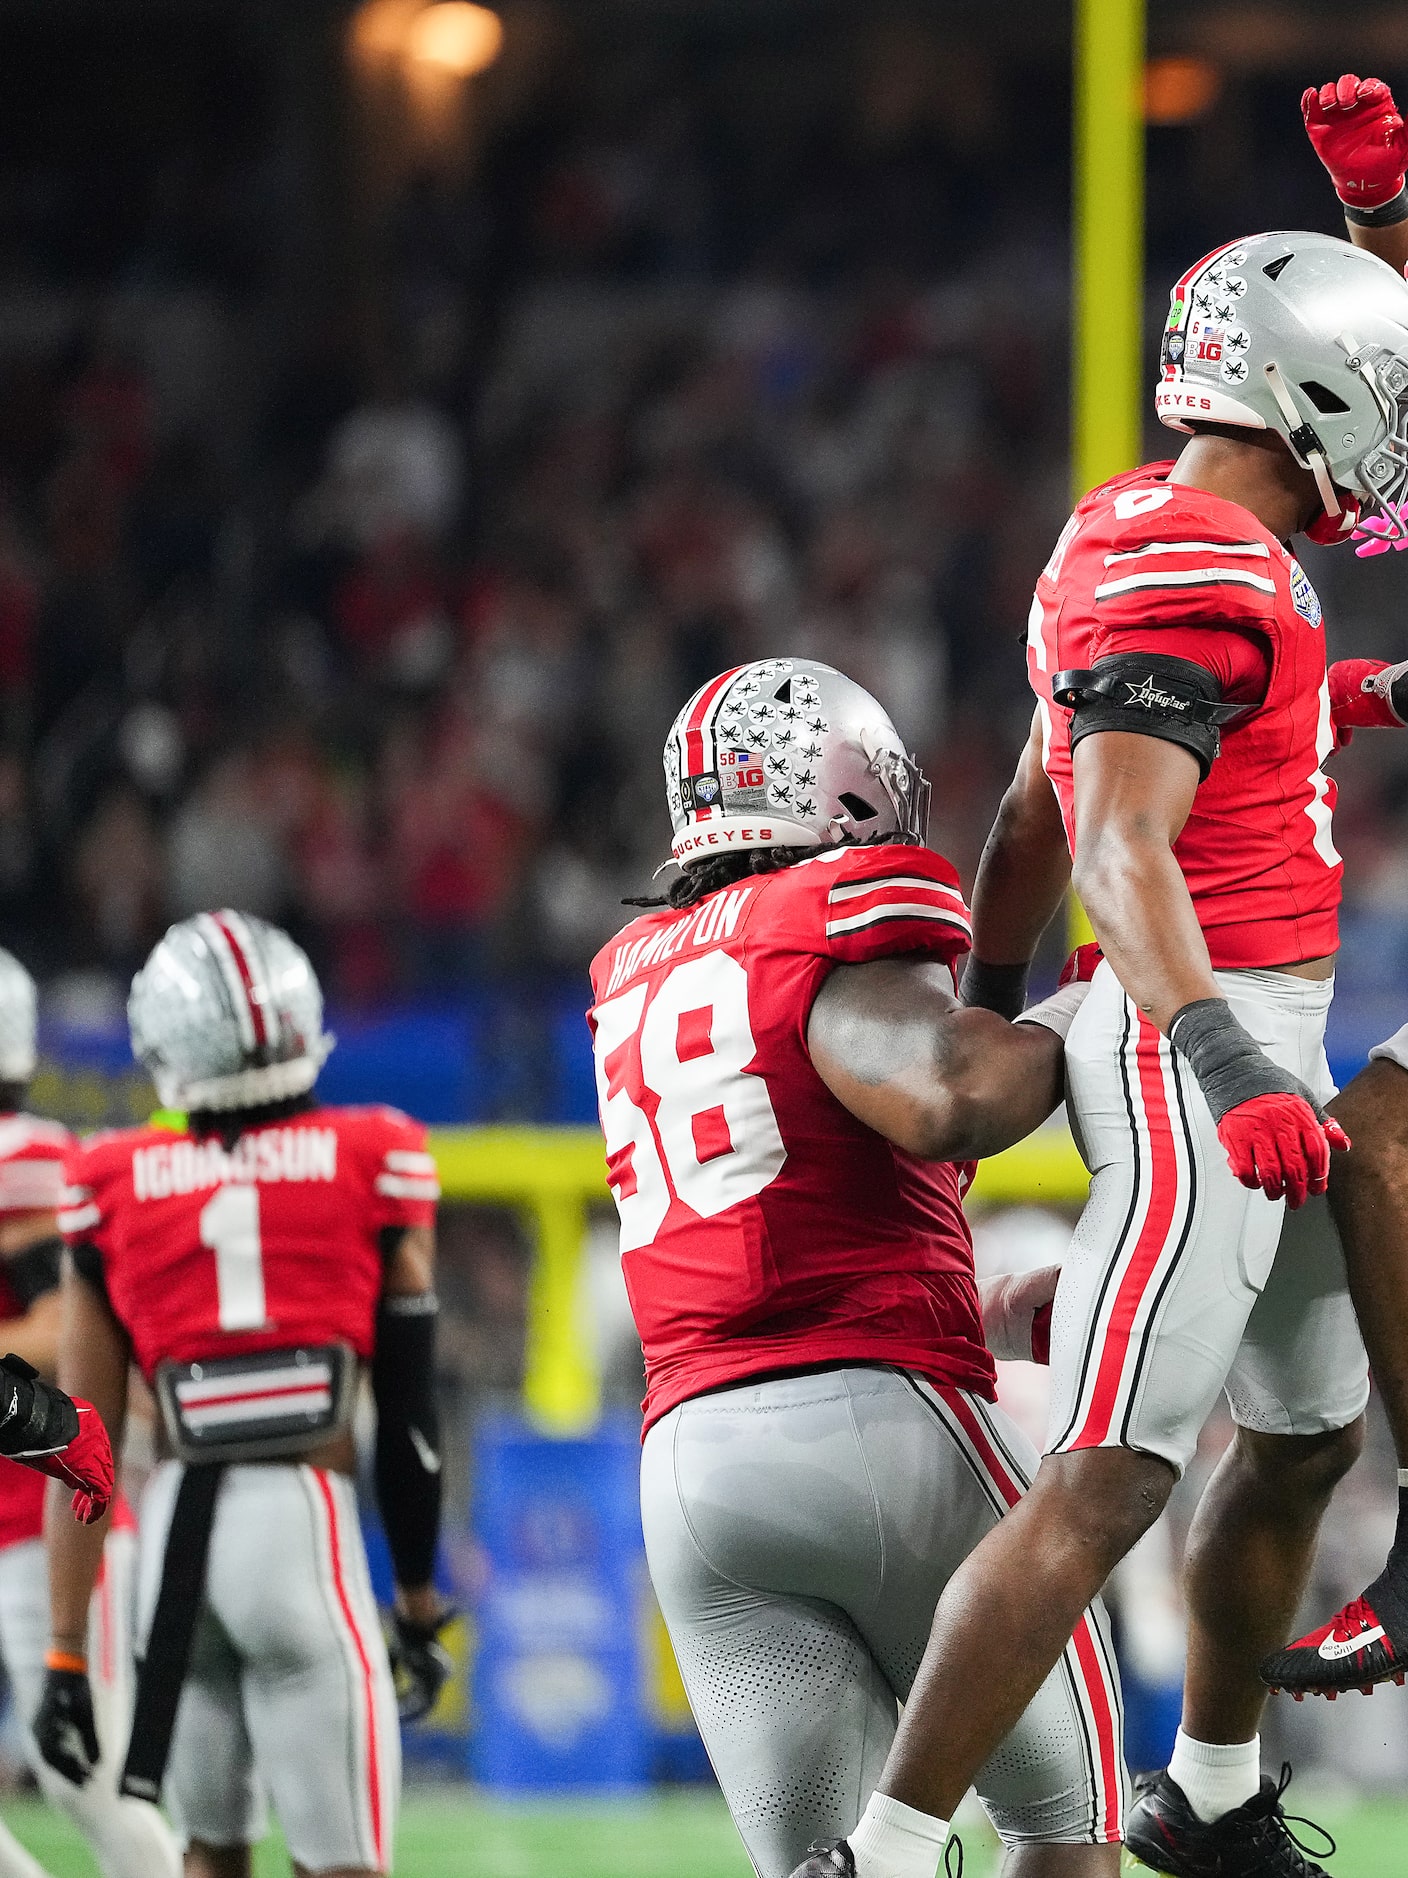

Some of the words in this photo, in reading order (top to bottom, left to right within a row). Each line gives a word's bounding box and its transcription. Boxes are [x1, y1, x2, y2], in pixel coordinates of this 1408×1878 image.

[1192, 321, 1200, 334] 6
[720, 752, 736, 766] 58
[672, 828, 773, 860] BUCKEYES
[605, 887, 754, 999] HAMILTON
[592, 948, 788, 1257] 58
[201, 1184, 267, 1331] 1
